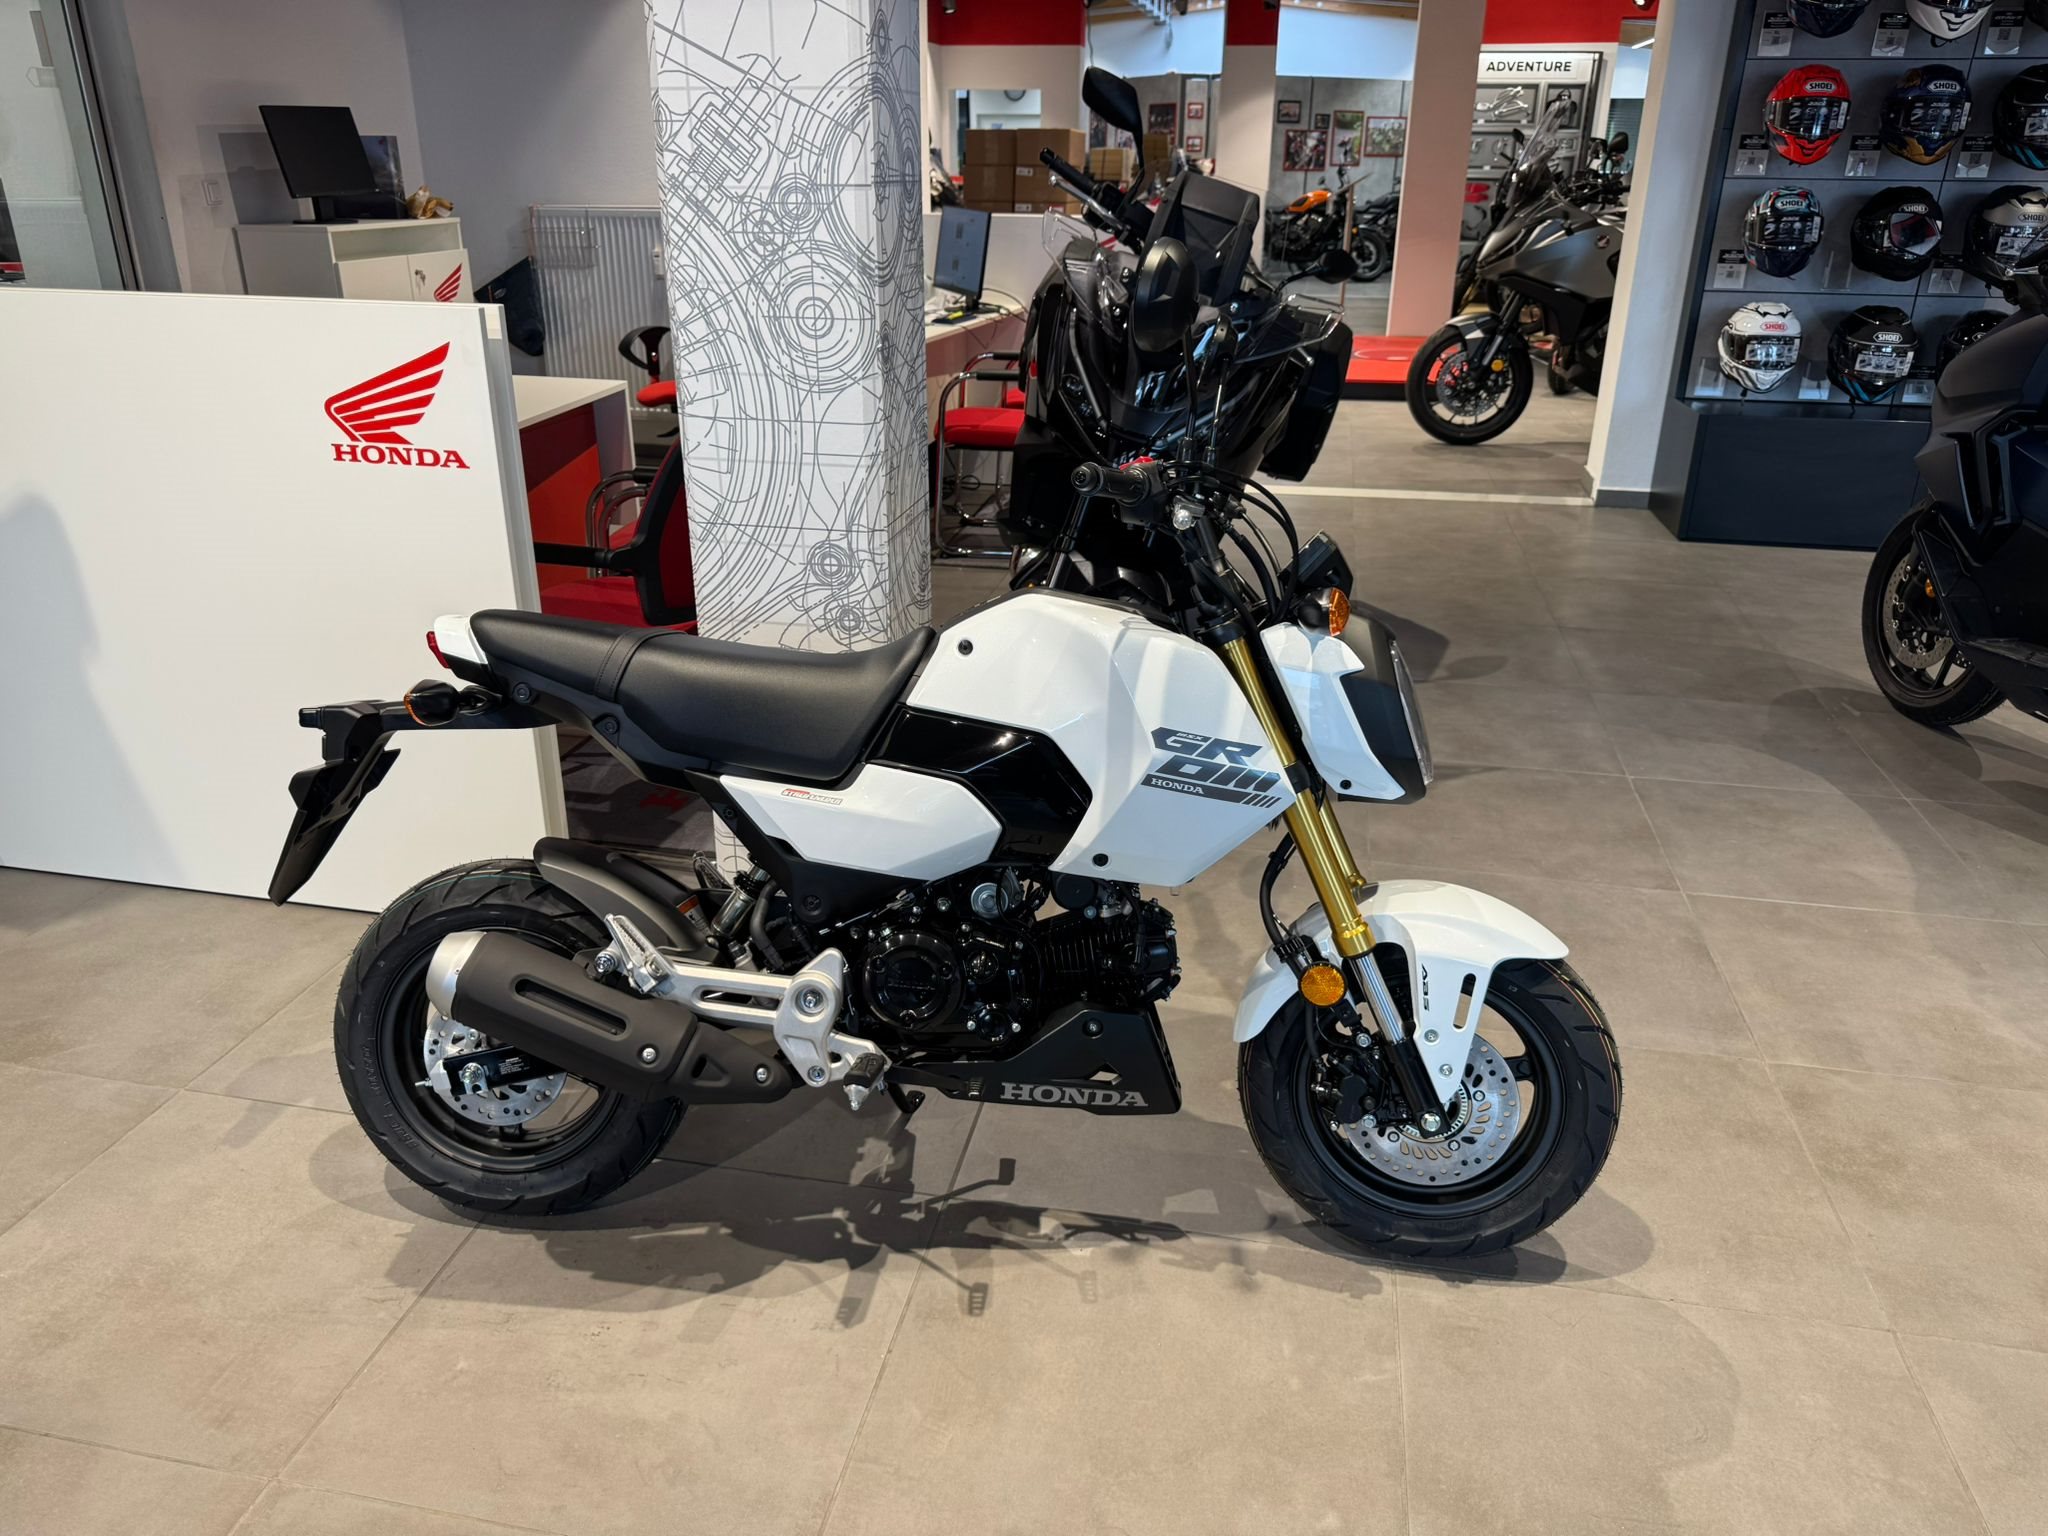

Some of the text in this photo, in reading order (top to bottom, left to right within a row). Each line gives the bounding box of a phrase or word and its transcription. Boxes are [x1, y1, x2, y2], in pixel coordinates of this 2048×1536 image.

[1486, 61, 1572, 72] ADVENTURE
[1809, 82, 1832, 90] SHOEI
[1933, 82, 1957, 90] SHOEI
[1780, 199, 1803, 207] SHOEI
[1903, 205, 1925, 213] SHOEI
[2022, 214, 2044, 222] SHOEI
[1877, 333, 1900, 342] SHOEI
[331, 443, 470, 469] HONDA
[1176, 732, 1204, 741] MSX
[1151, 778, 1205, 795] HONDA
[1422, 963, 1430, 1012] ABS
[1000, 1082, 1149, 1107] HONDA
